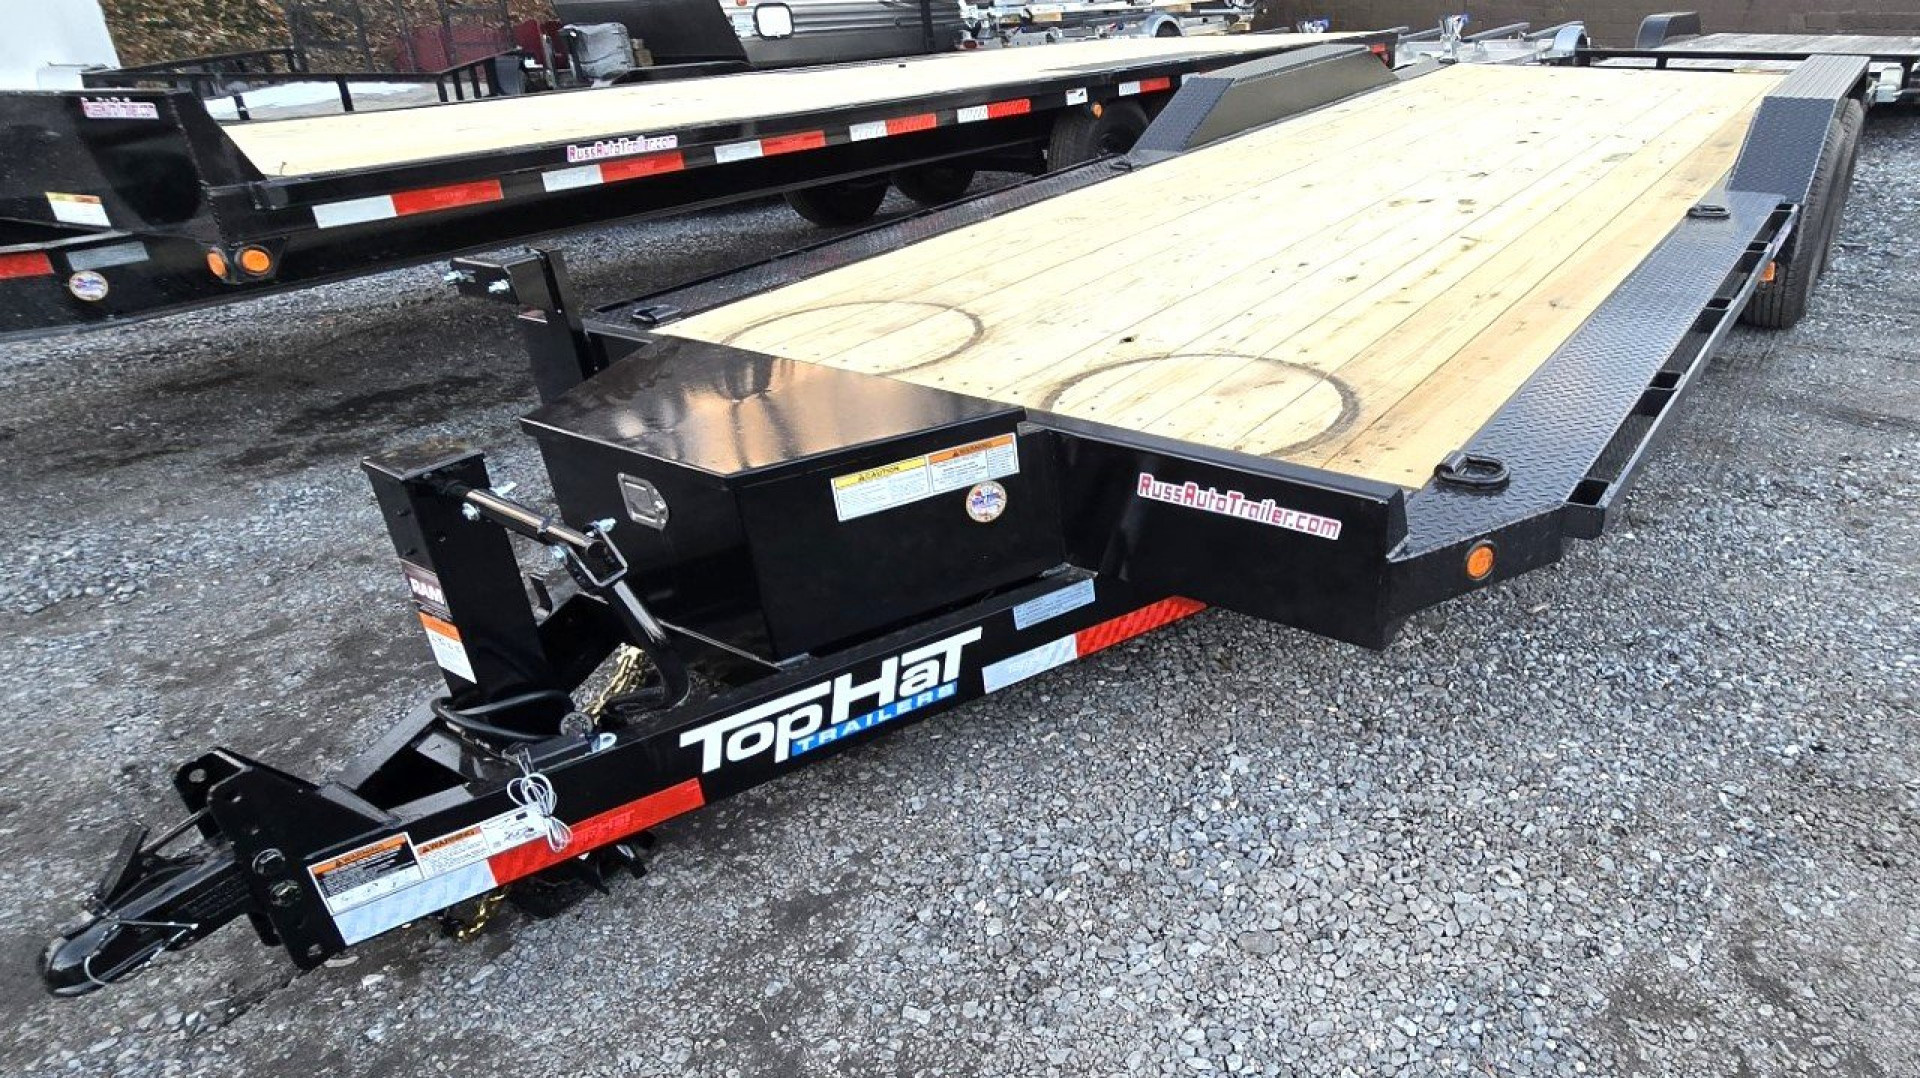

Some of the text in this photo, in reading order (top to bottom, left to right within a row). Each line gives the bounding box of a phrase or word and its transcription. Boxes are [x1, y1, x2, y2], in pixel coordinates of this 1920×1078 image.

[1138, 473, 1341, 539] RussAutoTrailer.com
[797, 682, 956, 752] TRAILERS
[430, 829, 475, 850] WARNING
